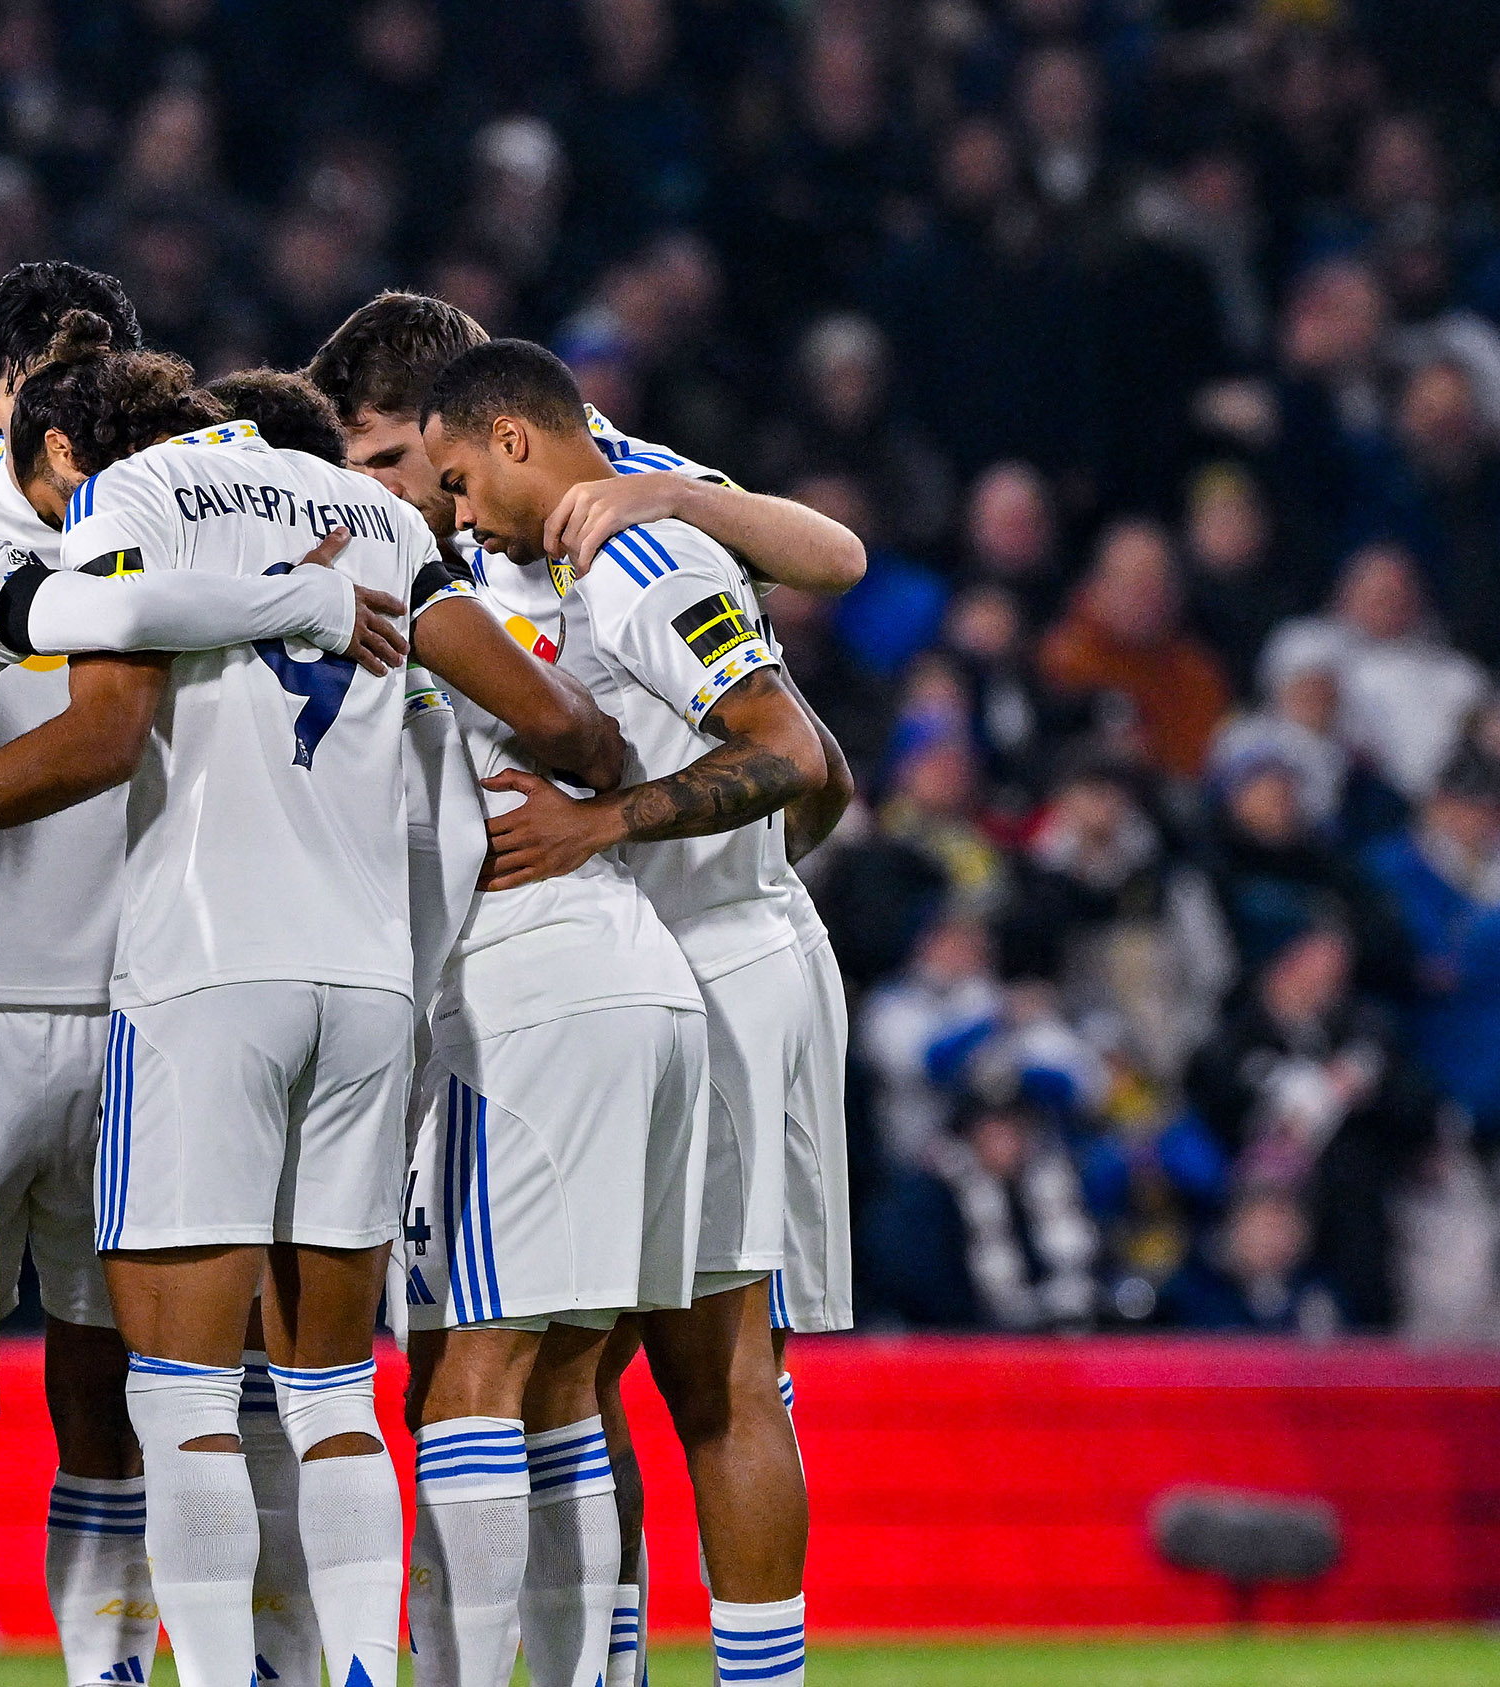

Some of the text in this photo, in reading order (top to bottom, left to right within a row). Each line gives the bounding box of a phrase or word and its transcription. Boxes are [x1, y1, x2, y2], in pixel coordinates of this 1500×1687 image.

[174, 483, 396, 543] CALVERT-LEWIN
[251, 561, 358, 772] 9
[403, 1170, 432, 1256] 4
